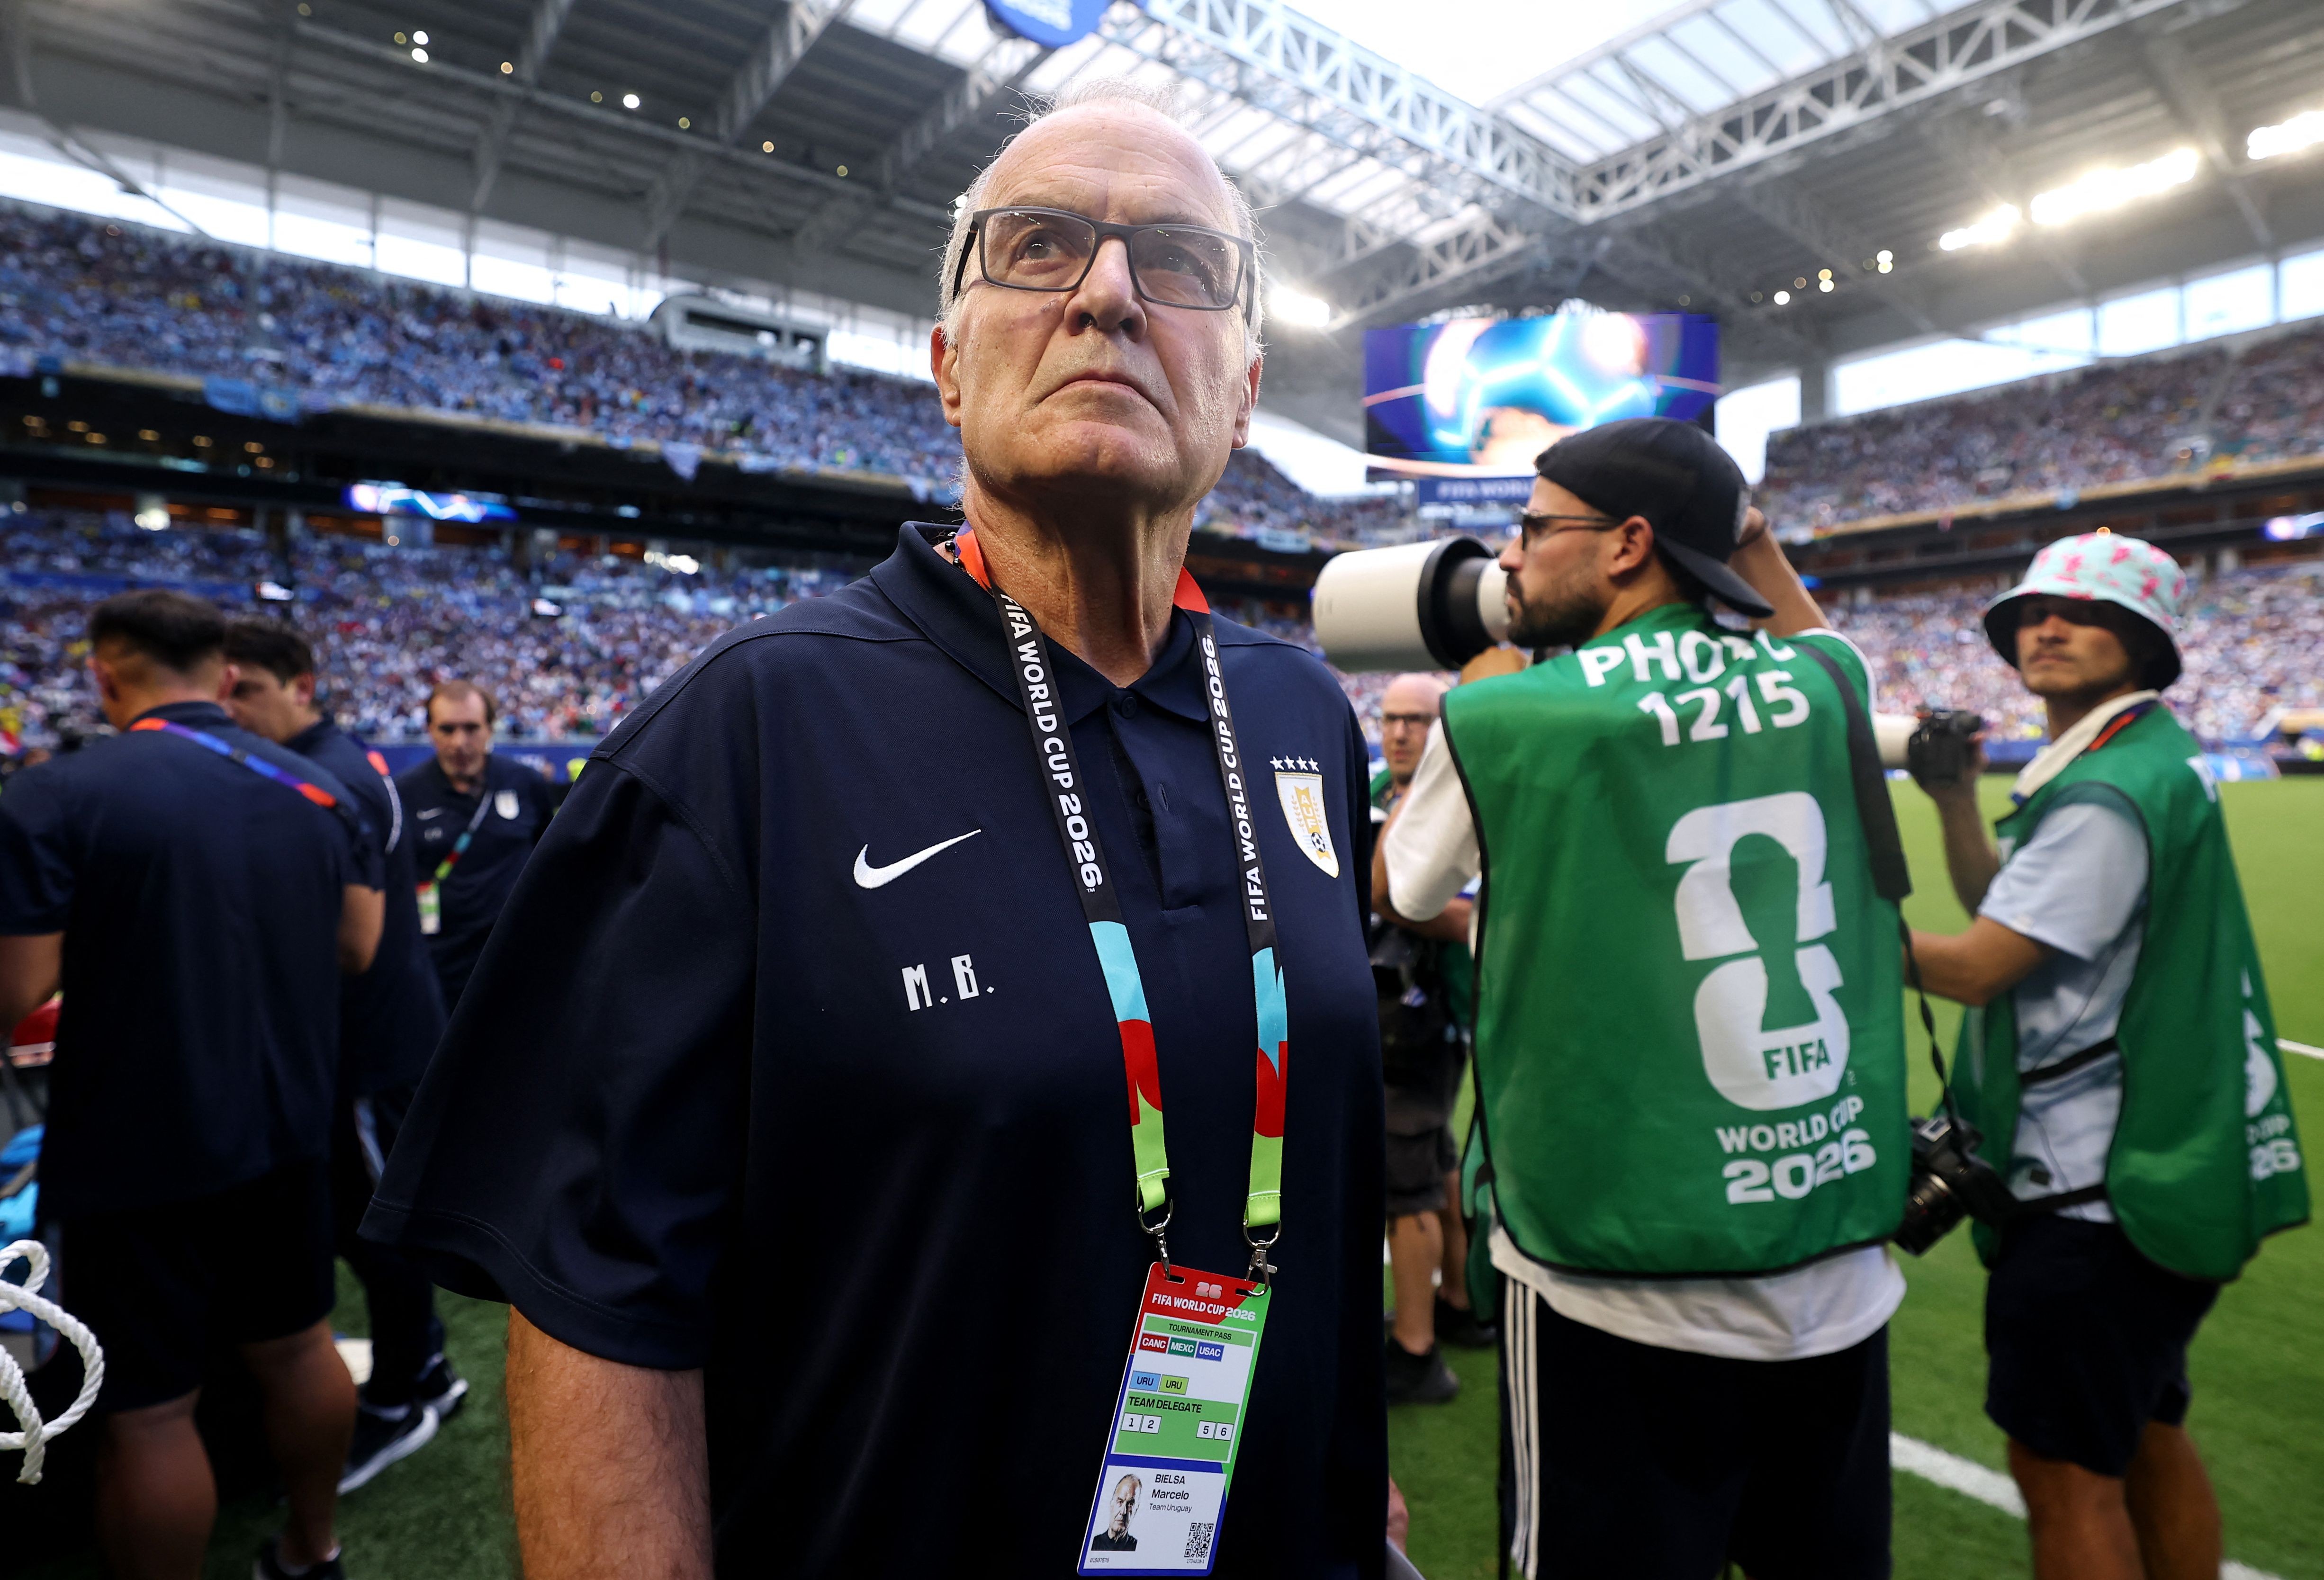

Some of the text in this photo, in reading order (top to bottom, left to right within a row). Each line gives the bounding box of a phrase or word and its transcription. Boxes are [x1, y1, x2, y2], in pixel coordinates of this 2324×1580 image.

[1000, 594, 1032, 639] FIFA
[1018, 640, 1057, 732] WORLD
[1044, 737, 1073, 788] CUP
[1637, 670, 1810, 746] 1215
[1202, 637, 1268, 920] FIFA WORLD CUP 2026
[1762, 1038, 1831, 1081] FIFA
[1715, 1095, 1864, 1153] WORLD CUP
[1722, 1128, 1877, 1205] 2026
[1195, 1282, 1223, 1299] 26
[1152, 1293, 1256, 1321] FIFA WORLD CUP 2026
[1169, 1323, 1232, 1340] TOURNAMENT PASS
[1142, 1338, 1221, 1357] CANC MEXC USAC
[1136, 1376, 1182, 1390] URU URU
[1129, 1397, 1202, 1413] TEAM DELEGATE
[1128, 1418, 1227, 1436] 1 2 5 6
[1155, 1474, 1185, 1484] BIELSA
[1151, 1489, 1189, 1500] Marcelo
[1167, 1504, 1192, 1513] Uruguay
